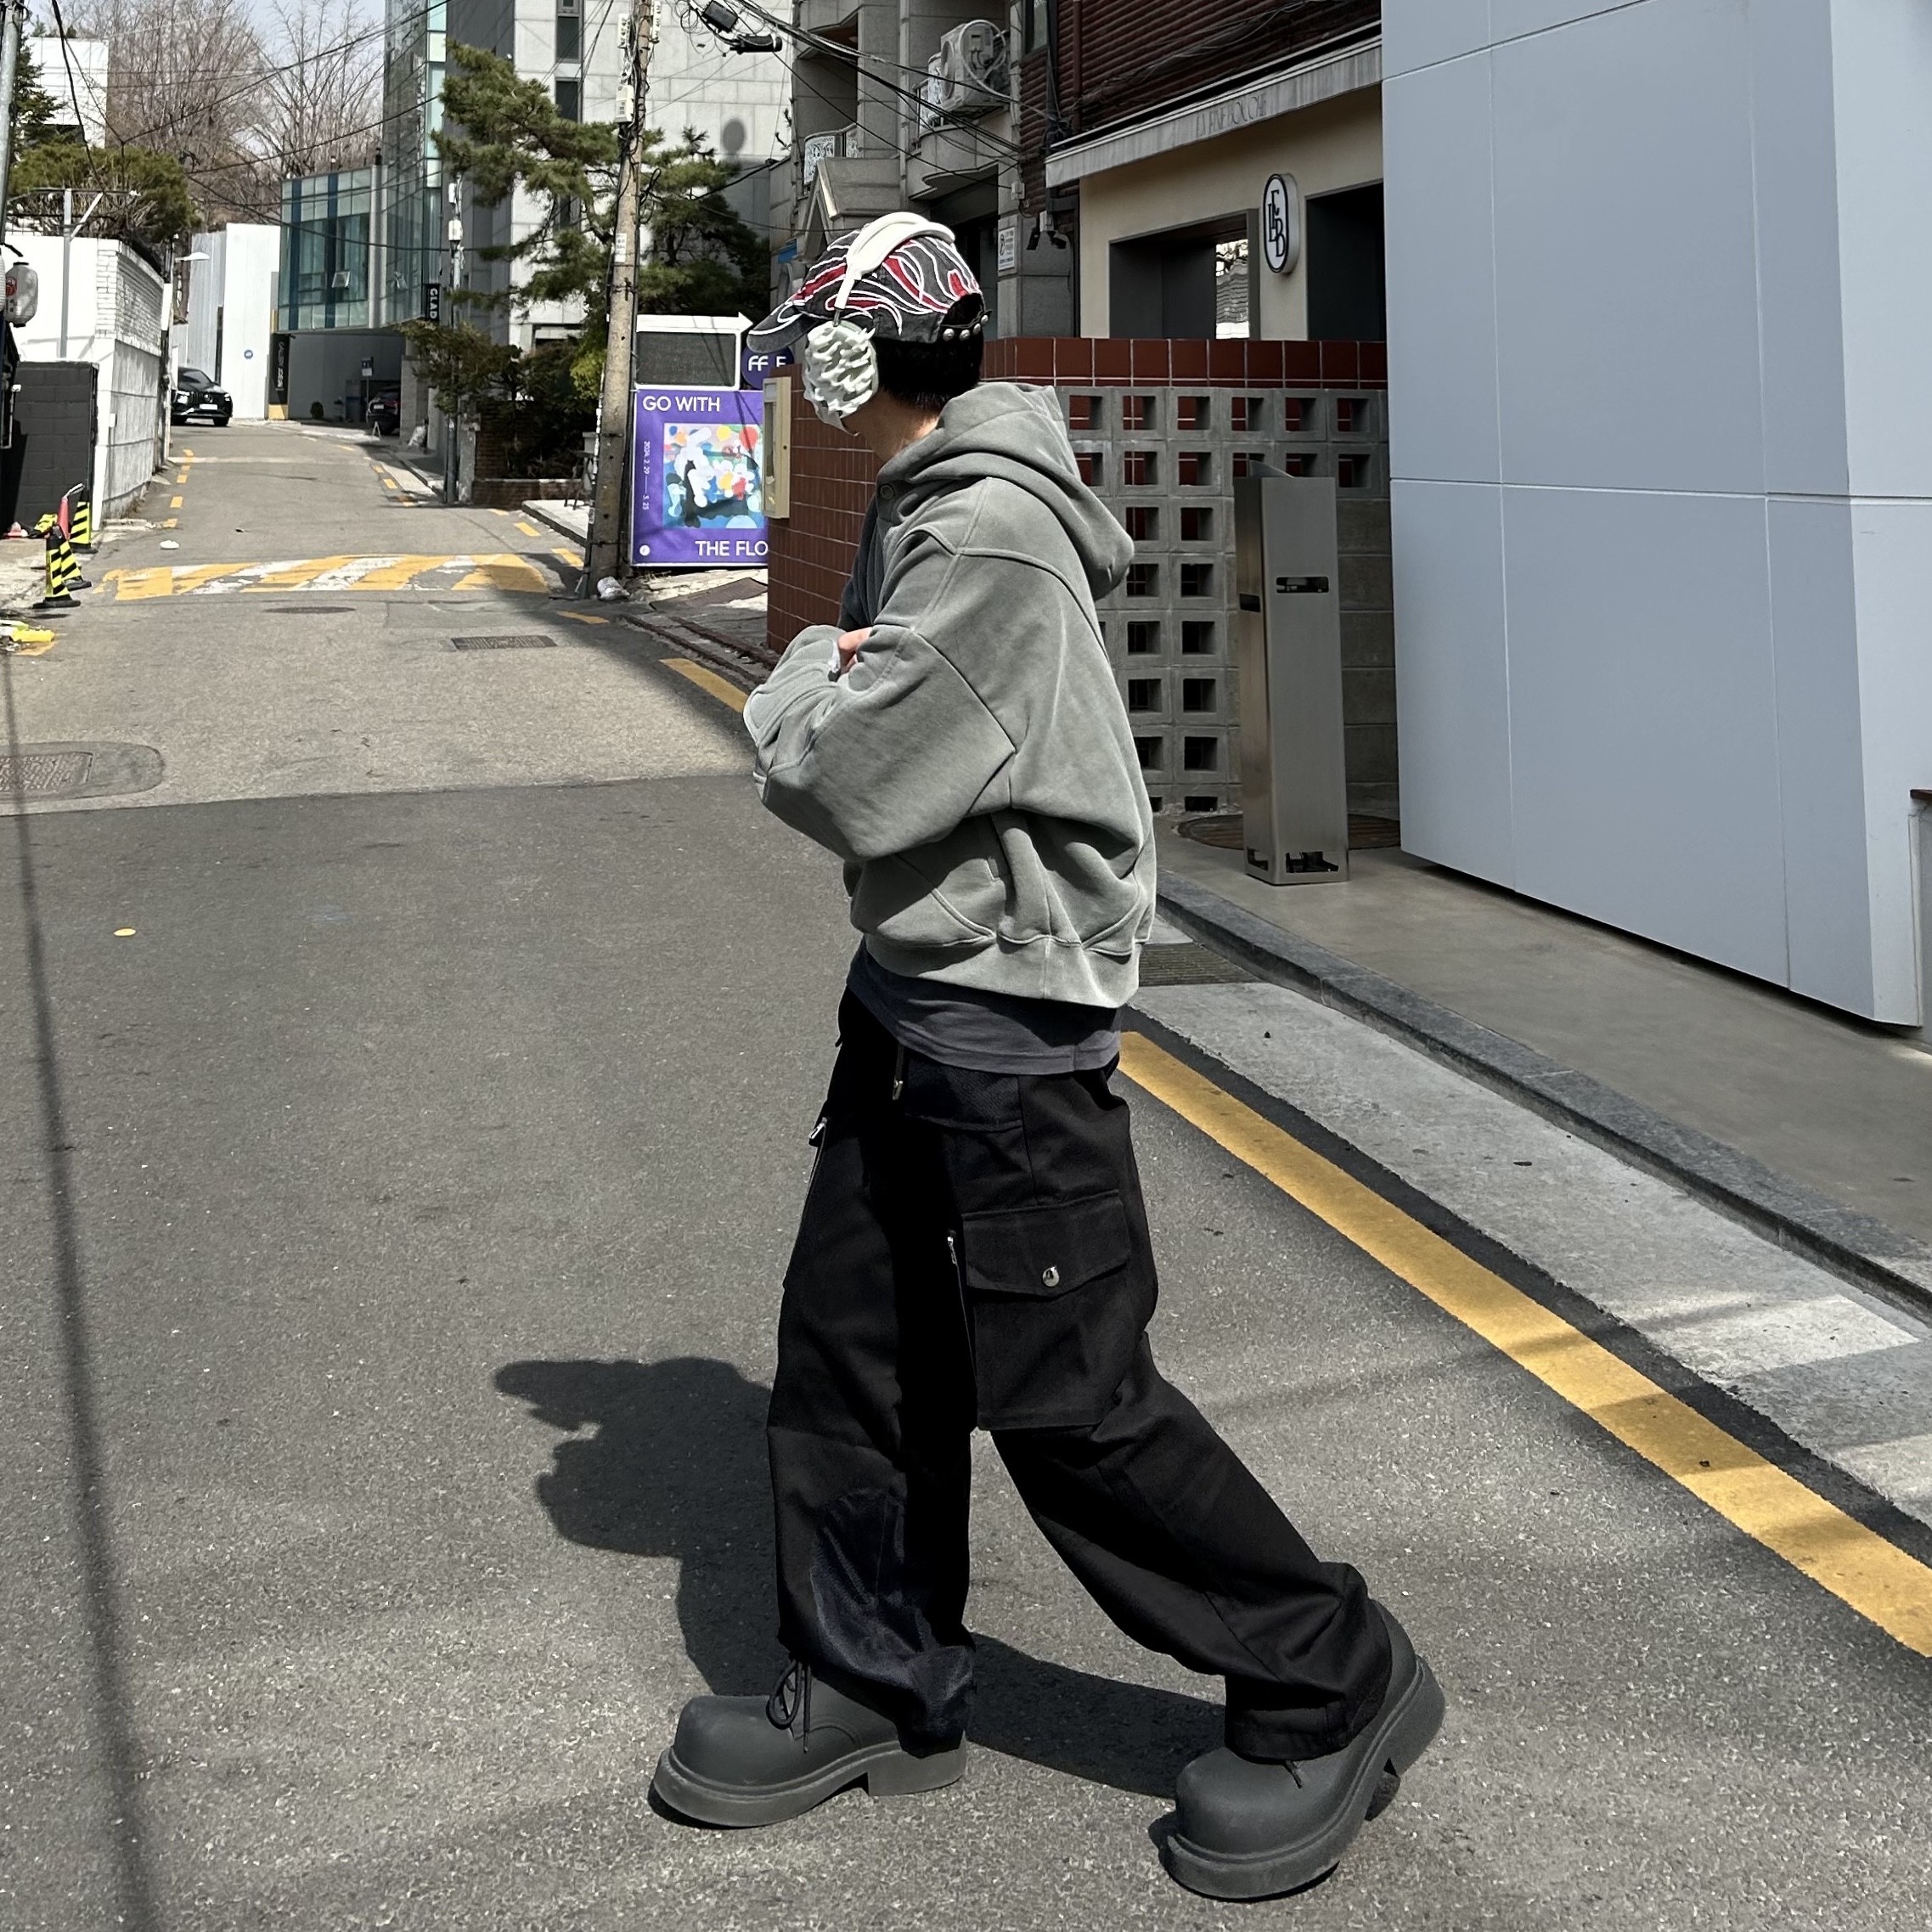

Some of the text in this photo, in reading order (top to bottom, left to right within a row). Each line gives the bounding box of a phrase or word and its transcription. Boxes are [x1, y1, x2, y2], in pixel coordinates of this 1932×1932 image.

[429, 287, 438, 319] CLAD
[642, 395, 721, 412] GO WITH
[695, 540, 769, 556] THE FLO
